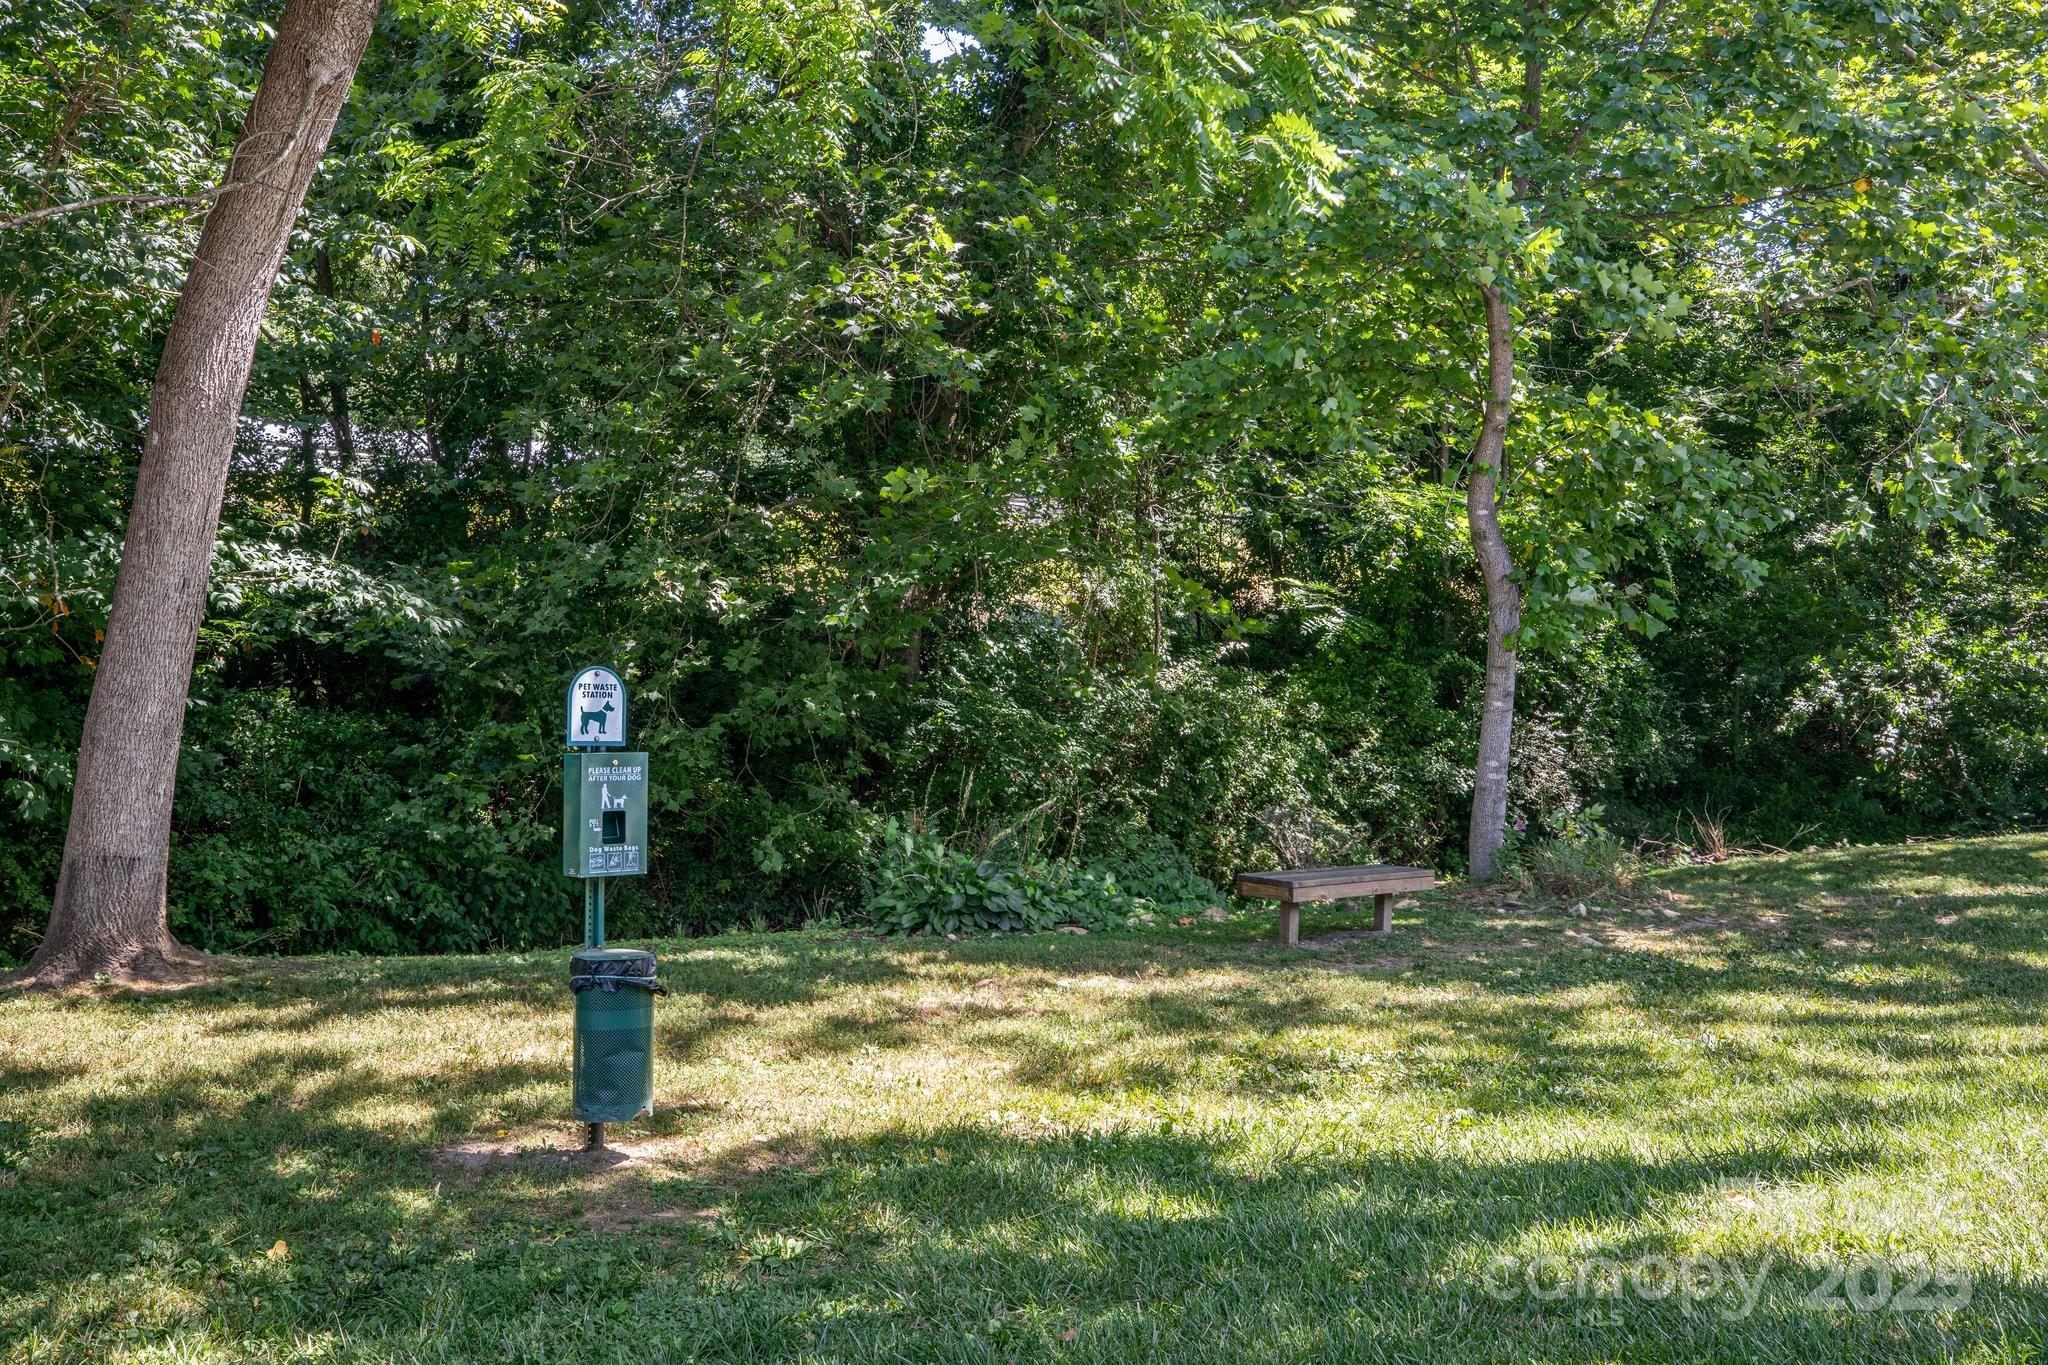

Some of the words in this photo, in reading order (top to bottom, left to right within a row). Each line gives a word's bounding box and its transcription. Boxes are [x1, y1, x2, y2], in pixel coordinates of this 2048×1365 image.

[578, 683, 591, 691] PET
[592, 683, 618, 691] WASTE
[582, 691, 613, 699] STATION
[611, 766, 632, 774] CLEAN
